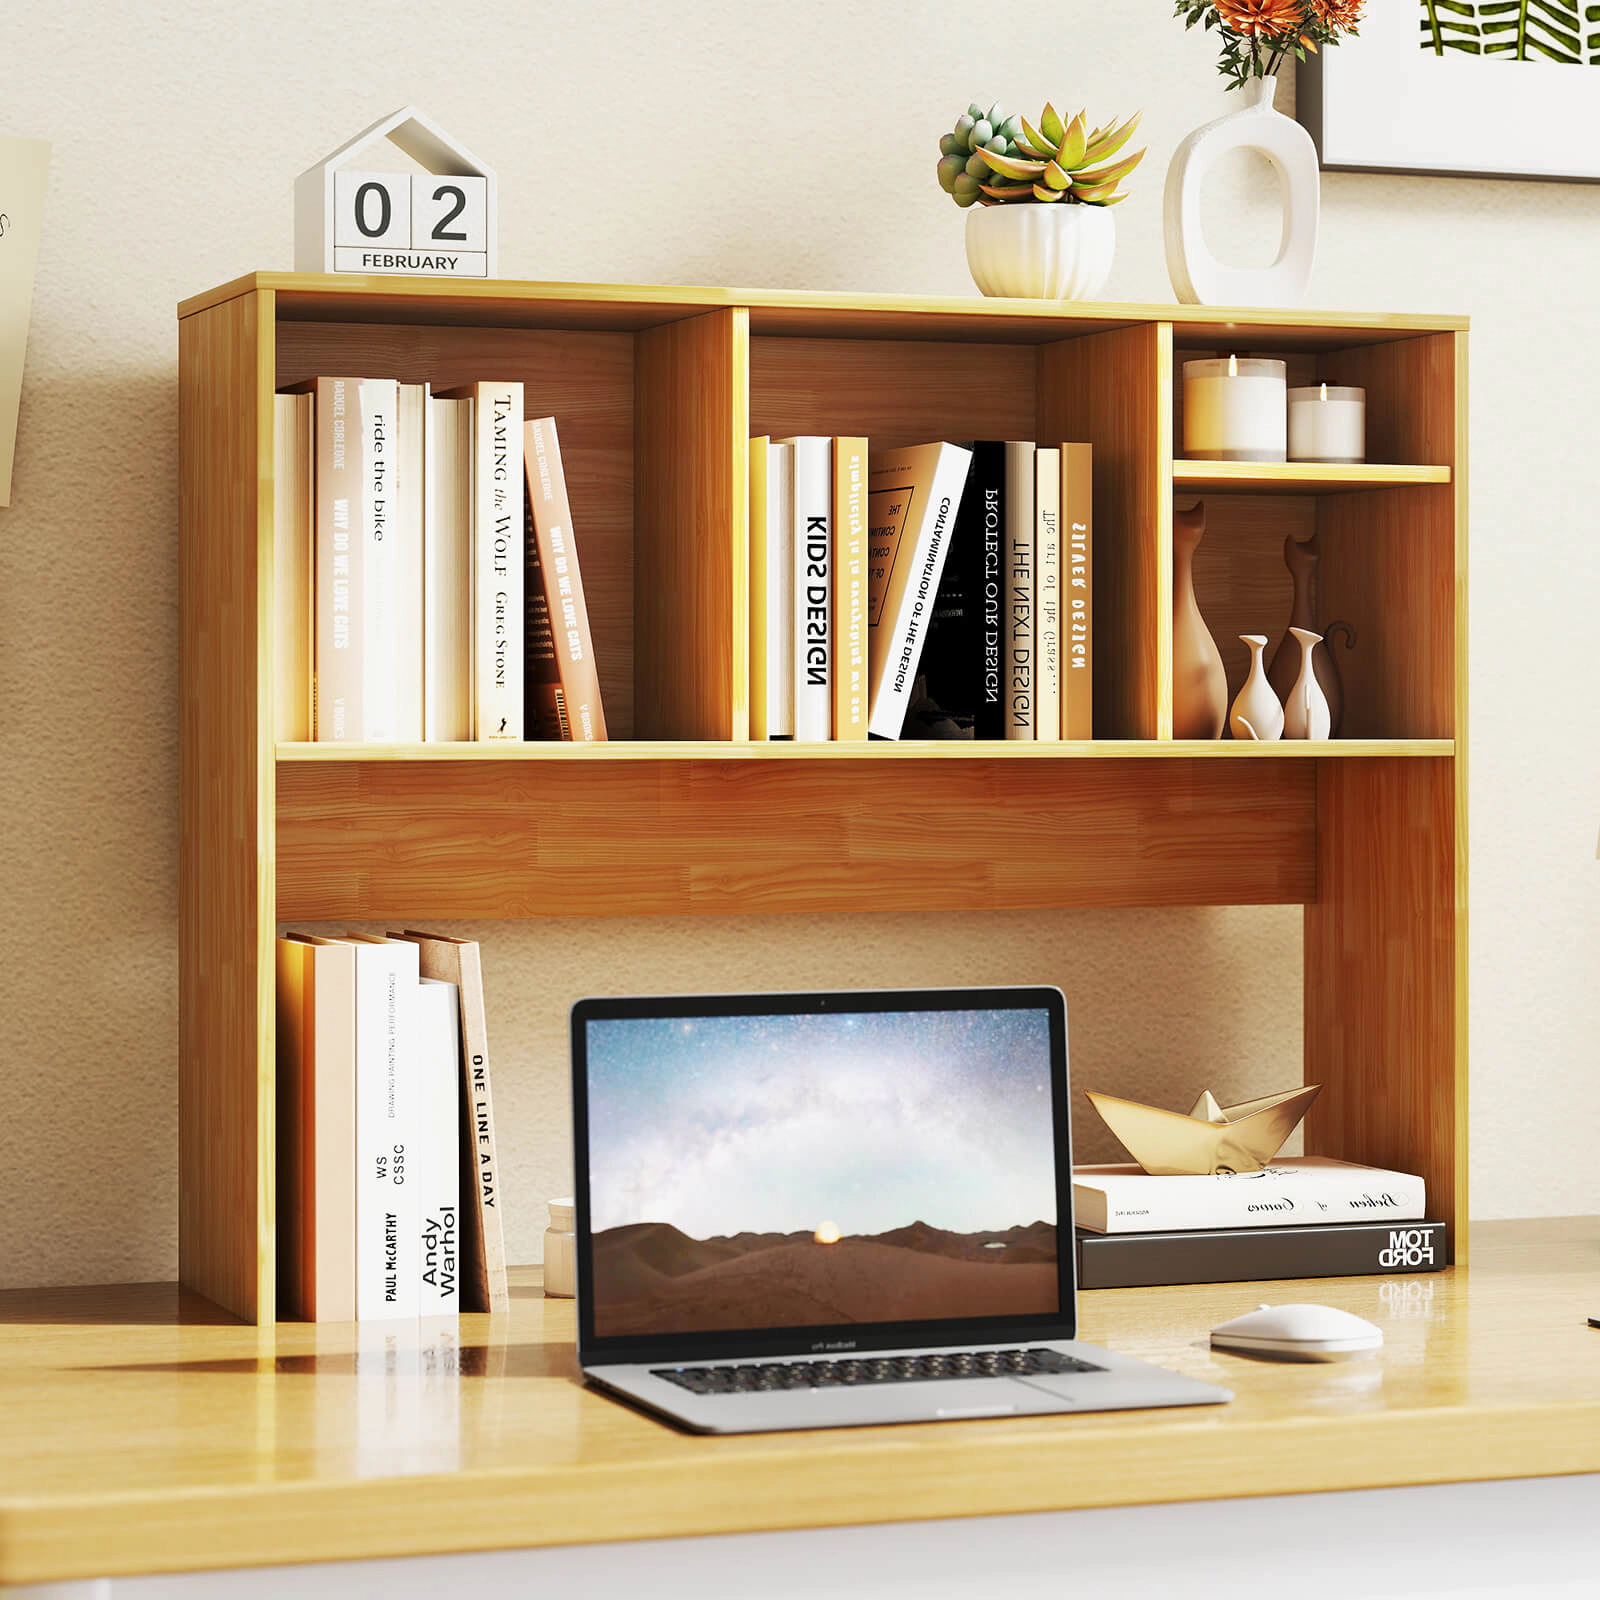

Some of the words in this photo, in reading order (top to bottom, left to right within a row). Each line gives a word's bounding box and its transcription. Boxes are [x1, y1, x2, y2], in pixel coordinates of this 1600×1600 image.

[362, 253, 459, 270] FEBRUARY
[374, 415, 386, 453] ride
[494, 395, 511, 481] TAMING
[374, 461, 385, 492] the
[334, 499, 349, 529] WHY
[494, 489, 507, 511] the
[374, 500, 386, 542] bike
[334, 532, 349, 550] DO
[494, 516, 511, 577] WOLF
[550, 526, 565, 554] WHY
[334, 554, 349, 576] WE
[555, 556, 569, 574] DO
[334, 579, 349, 611] LOVE
[556, 576, 572, 596] WE
[495, 591, 508, 635] GREG
[561, 597, 577, 629] LOVE
[334, 615, 349, 649] CATS
[567, 630, 583, 661] CATS
[495, 640, 508, 689] STONE
[472, 1054, 486, 1092] ONE
[476, 1102, 490, 1145] LINE
[376, 1156, 388, 1179] WS
[393, 1144, 405, 1185] CSSC
[480, 1153, 491, 1165] A
[482, 1172, 495, 1208] DAY
[421, 1218, 442, 1286] Andy
[439, 1206, 455, 1298] Warhol
[385, 1273, 397, 1302] PAUL
